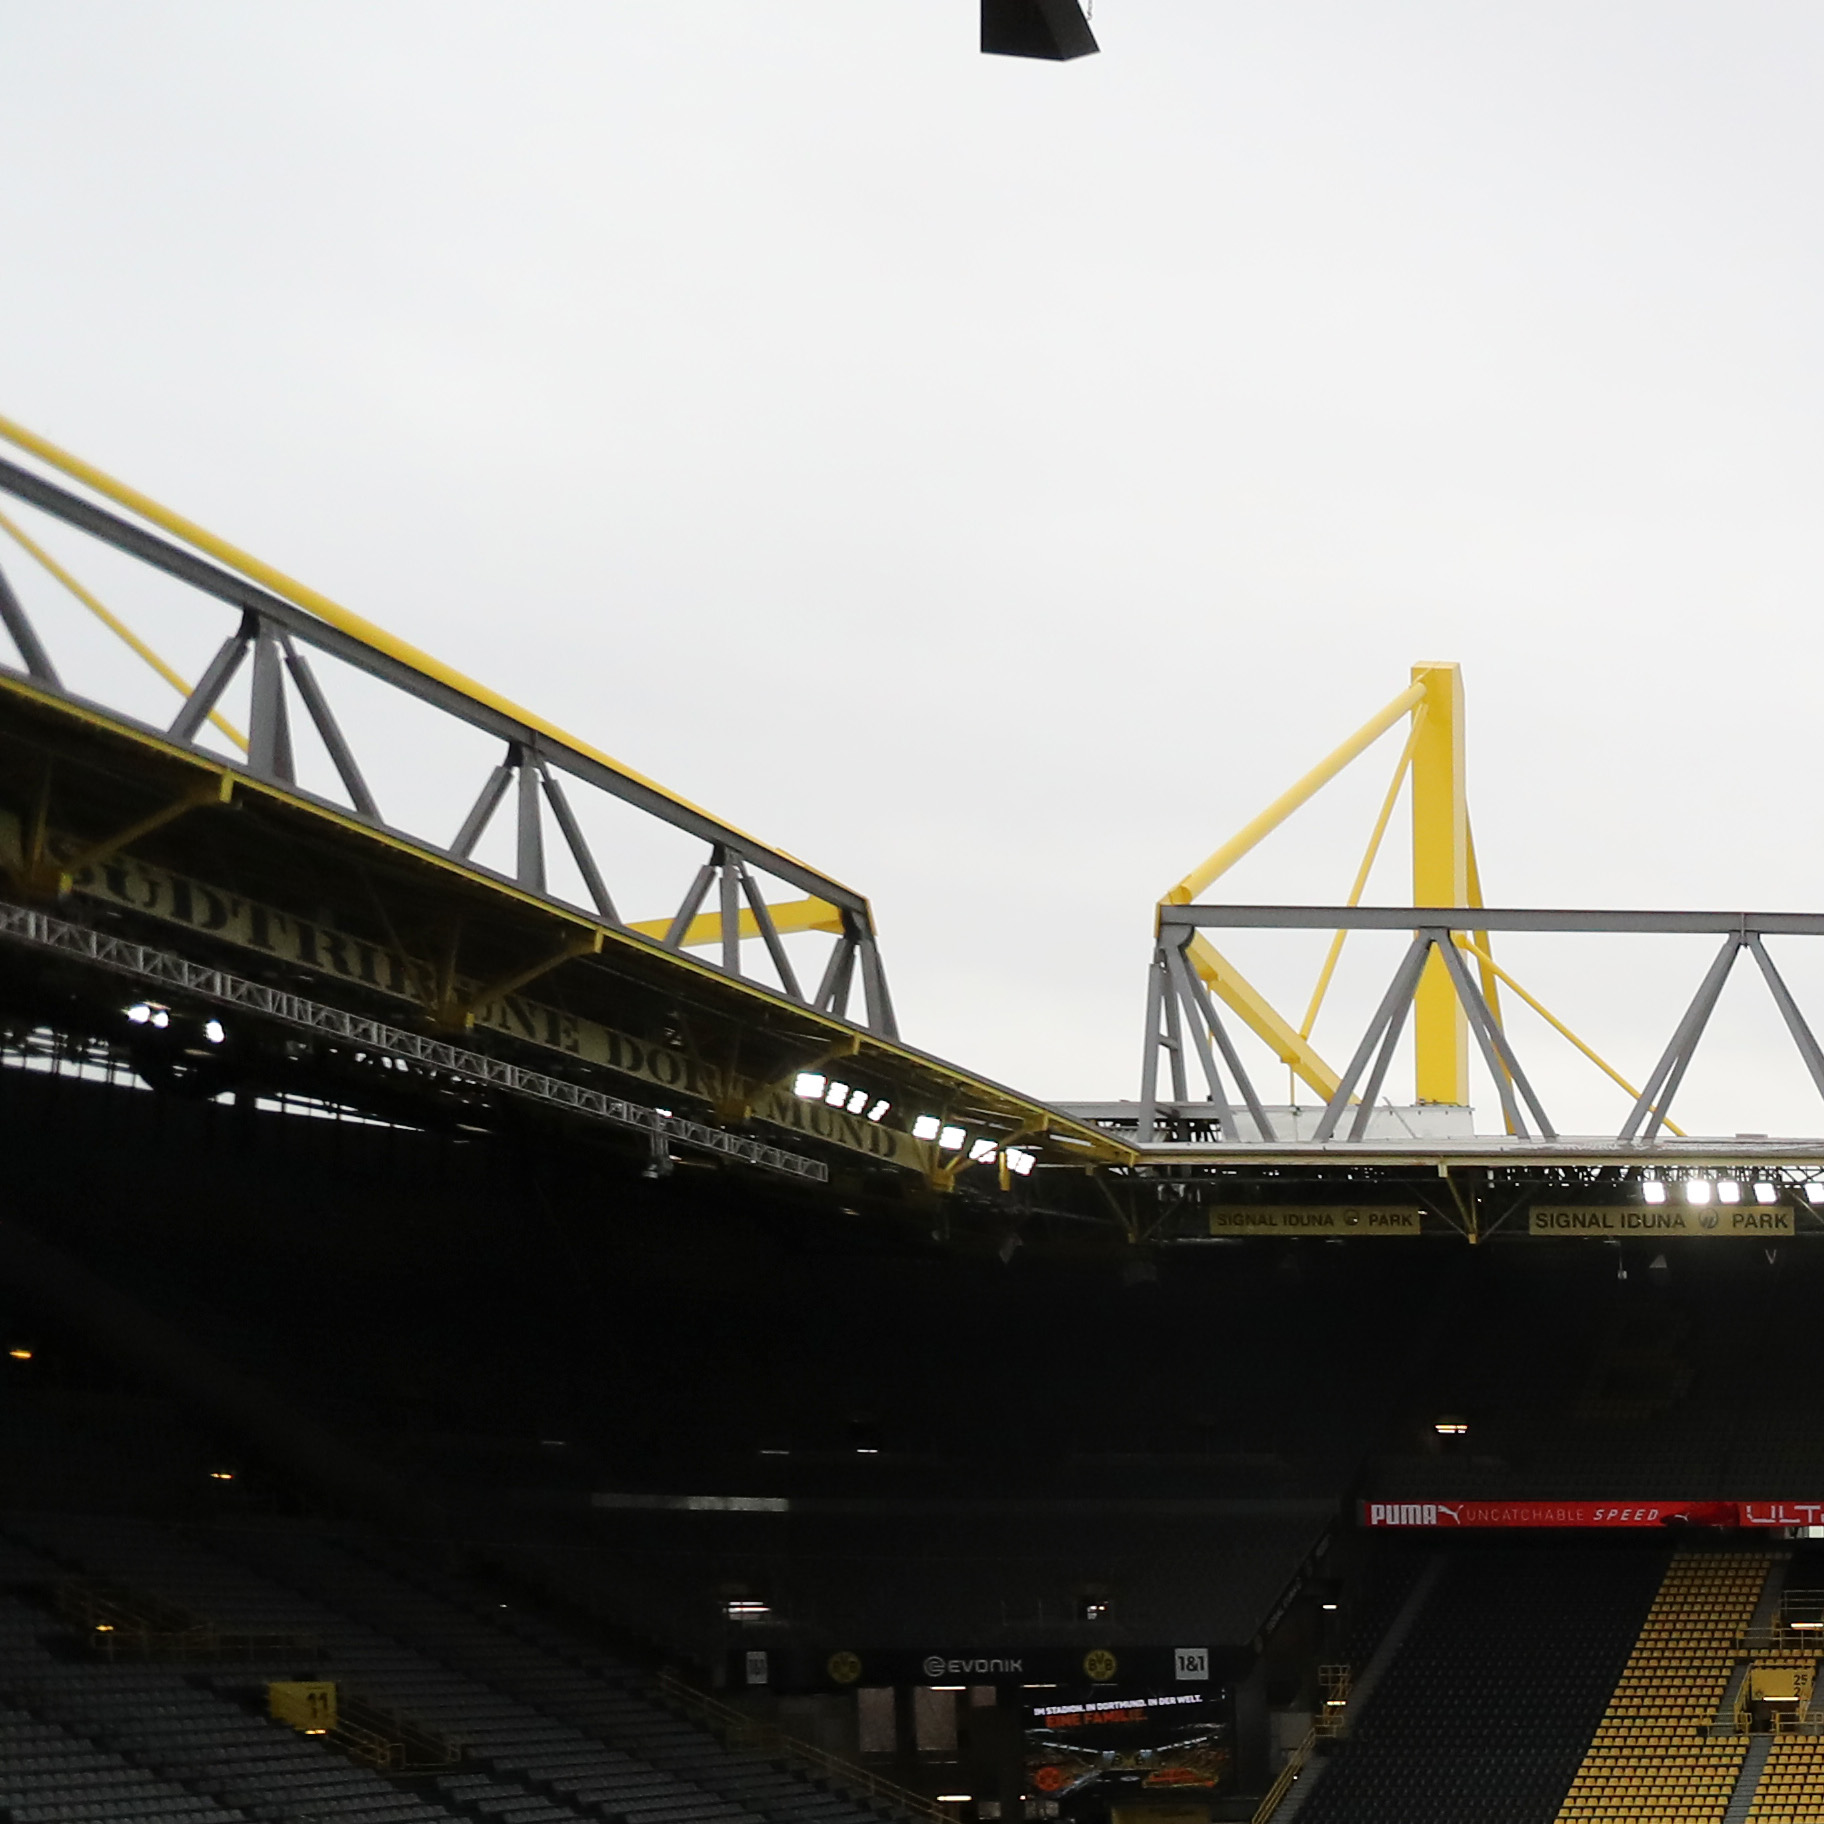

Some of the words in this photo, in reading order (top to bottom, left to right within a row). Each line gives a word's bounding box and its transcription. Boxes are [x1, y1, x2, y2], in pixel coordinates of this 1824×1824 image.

[1217, 1214, 1279, 1227] SIGNAL
[1282, 1214, 1334, 1228] IDUNA
[1368, 1214, 1414, 1228] PARK
[1535, 1212, 1615, 1229] SIGNAL
[1620, 1212, 1686, 1229] IDUNA
[1731, 1212, 1788, 1229] PARK
[1371, 1504, 1437, 1525] PUMA
[1466, 1508, 1584, 1522] UNCATCHABLE
[1593, 1508, 1659, 1522] SPEED
[947, 1658, 1023, 1675] EVONIK
[1178, 1655, 1206, 1672] 1&1
[1793, 1674, 1808, 1685] 25
[307, 1692, 329, 1719] 11
[1045, 1712, 1083, 1728] EINE
[1084, 1708, 1148, 1725] FAMILIE.
